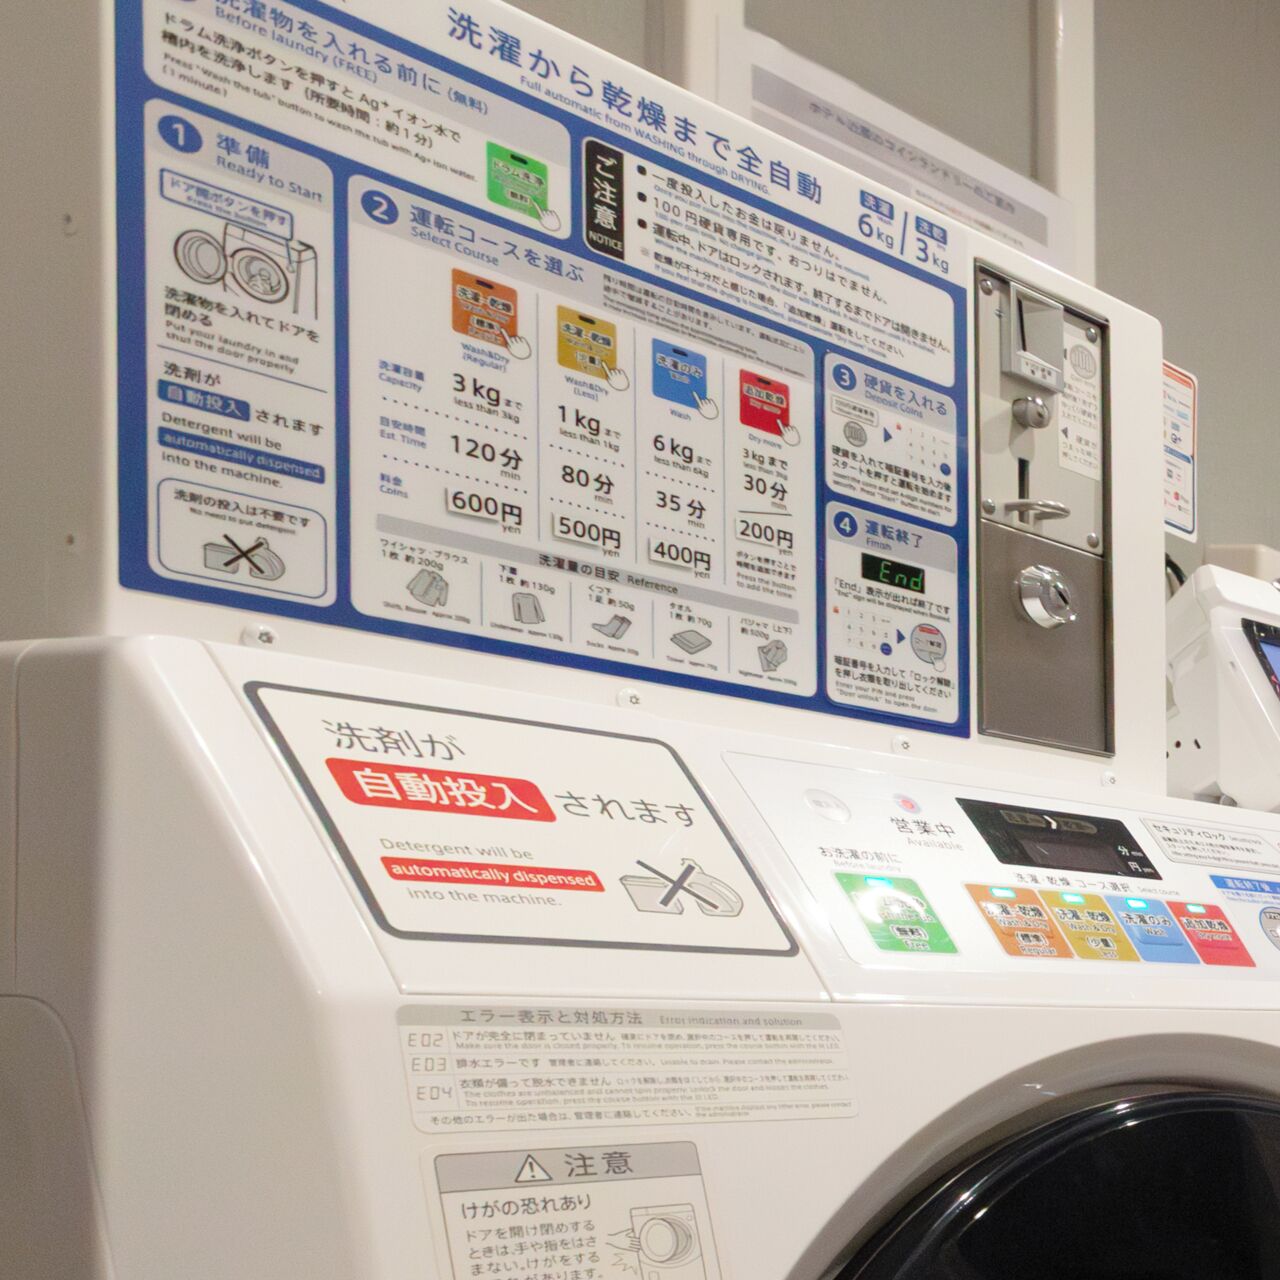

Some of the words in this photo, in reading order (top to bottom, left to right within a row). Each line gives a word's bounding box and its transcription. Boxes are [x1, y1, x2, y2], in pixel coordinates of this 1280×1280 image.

[215, 6, 268, 36] Before
[271, 30, 328, 64] laundry
[332, 54, 378, 84] (FREE)
[447, 7, 822, 204] 洗濯から乾燥まで全自動
[172, 123, 184, 146] 1
[519, 75, 543, 97] Full
[544, 86, 603, 121] automatic
[604, 111, 632, 135] from
[634, 122, 686, 158] WASHING
[687, 149, 728, 177] through
[216, 133, 270, 169] 準備
[216, 156, 266, 184] Ready
[269, 173, 284, 189] to
[288, 182, 322, 202] Start
[593, 155, 617, 231] ご注意
[372, 197, 388, 220] 2
[410, 204, 584, 282] 運転コースを選ぶ
[411, 227, 451, 249] Select
[455, 242, 499, 266] Course
[588, 230, 623, 251] NOTICE
[164, 286, 320, 343] 洗濯物を入れてドアを
[164, 360, 221, 386] 洗剤が
[167, 385, 242, 417] 自動投入
[255, 410, 324, 436] されます
[475, 401, 498, 416] than
[162, 412, 233, 438] Detergent
[237, 429, 261, 445] will
[265, 437, 282, 451] be
[400, 432, 427, 449] Time
[162, 452, 190, 467] into
[195, 460, 217, 473] the
[164, 433, 254, 463] automatically
[257, 453, 321, 478] dispensed
[450, 435, 523, 471] 120分
[500, 468, 521, 481] min
[561, 465, 614, 495] 80分
[743, 474, 788, 502] 30分
[174, 488, 311, 528] 洗剤の投入は不要です
[452, 490, 523, 526] 600円
[656, 490, 706, 519] 35分
[559, 516, 621, 549] 500円
[739, 519, 793, 549] 200円
[839, 517, 851, 533] 4
[654, 540, 712, 572] 400円
[628, 574, 679, 595] Reference
[879, 561, 923, 591] End
[323, 718, 465, 761] 洗剤が
[353, 768, 539, 815] 自動投入
[555, 790, 695, 828] されます
[889, 816, 956, 837] 営業中
[379, 837, 472, 859] Detergent
[476, 845, 506, 859] will
[510, 846, 534, 861] be
[907, 837, 964, 851] Available
[390, 861, 510, 886] automatically
[513, 869, 596, 890] dispensed
[407, 886, 444, 902] into
[449, 888, 479, 903] the
[483, 891, 562, 908] machine.
[460, 1009, 643, 1025] エラー表示と対処方法
[763, 1016, 802, 1027] solution
[407, 1032, 443, 1048] E02
[411, 1056, 447, 1072] E03
[565, 1151, 633, 1177] 注意
[462, 1194, 592, 1219] けがの恐れあり
[466, 1220, 595, 1242] ドアを開け閉めする
